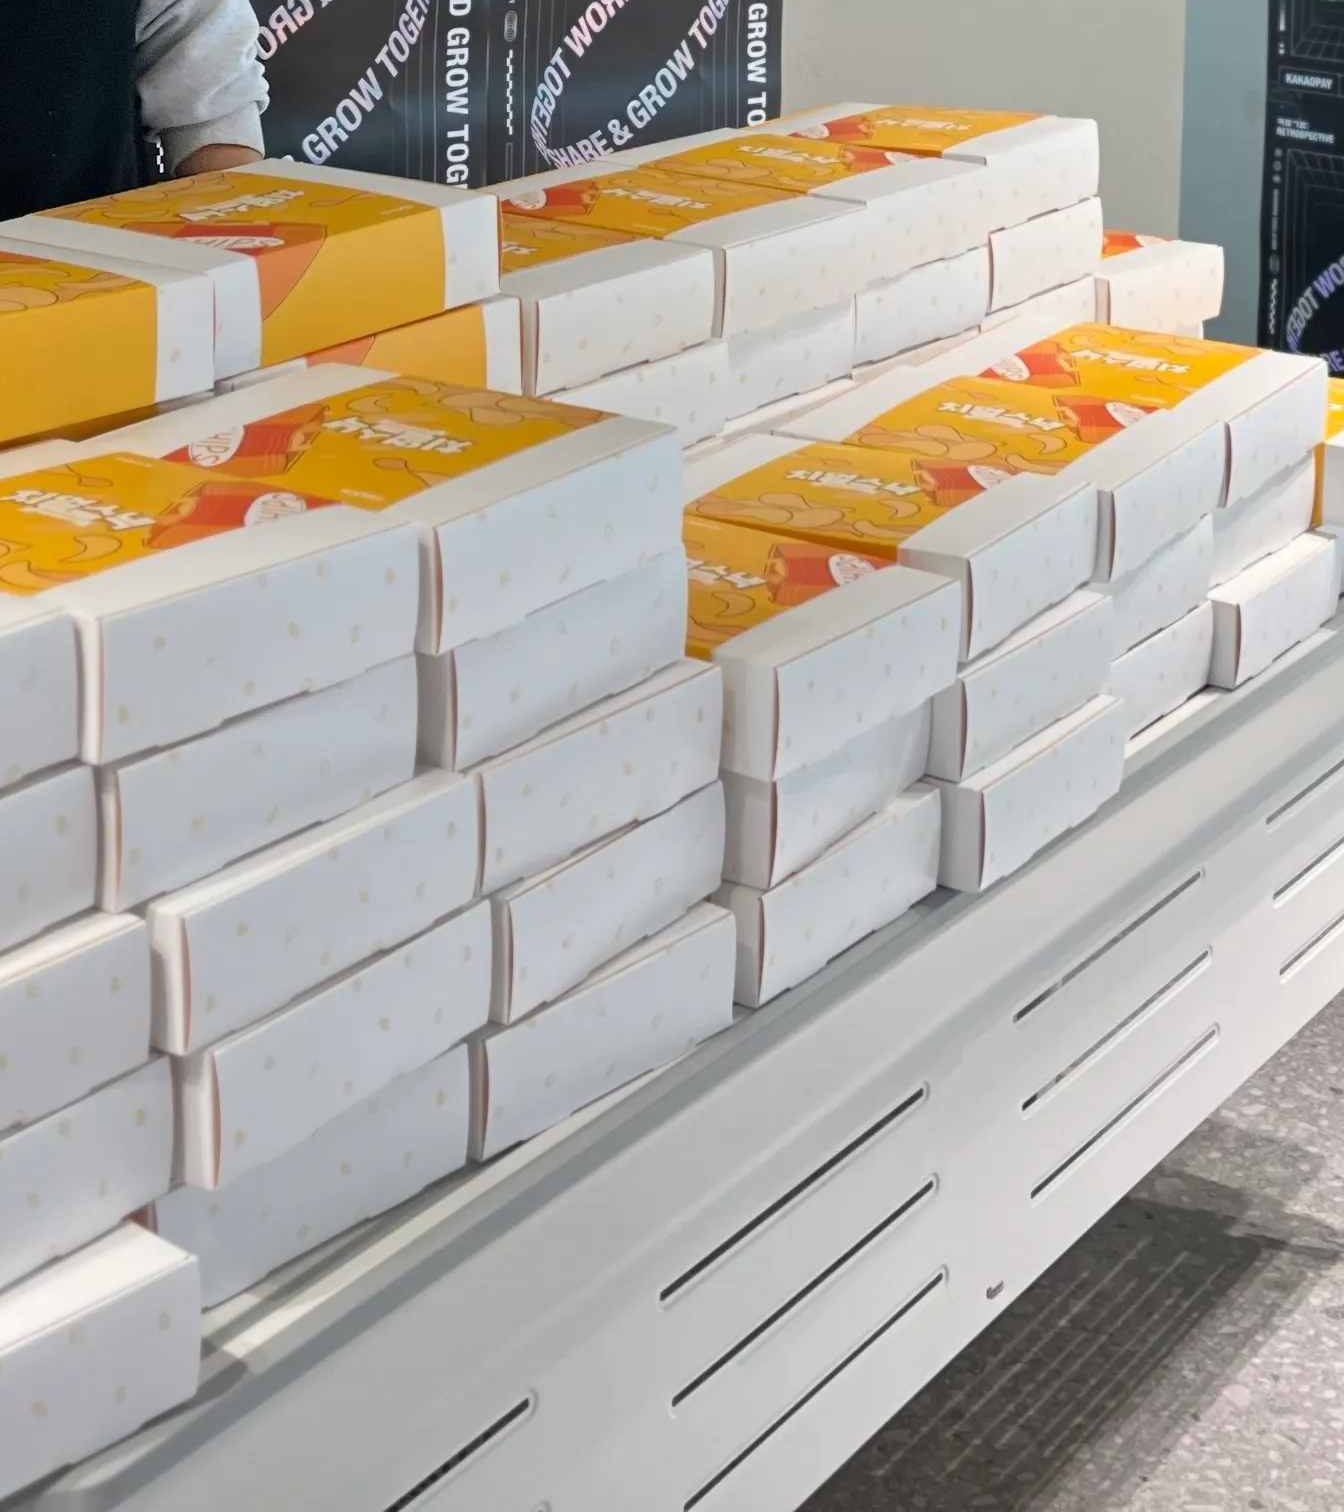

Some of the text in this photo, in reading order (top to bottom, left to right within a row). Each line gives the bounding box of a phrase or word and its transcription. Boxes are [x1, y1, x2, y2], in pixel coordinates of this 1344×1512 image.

[445, 26, 470, 116] GROW
[626, 40, 694, 127] GROW
[746, 2, 767, 84] GROW
[1285, 73, 1332, 89] KAKAOPAY
[301, 67, 383, 164] GROW
